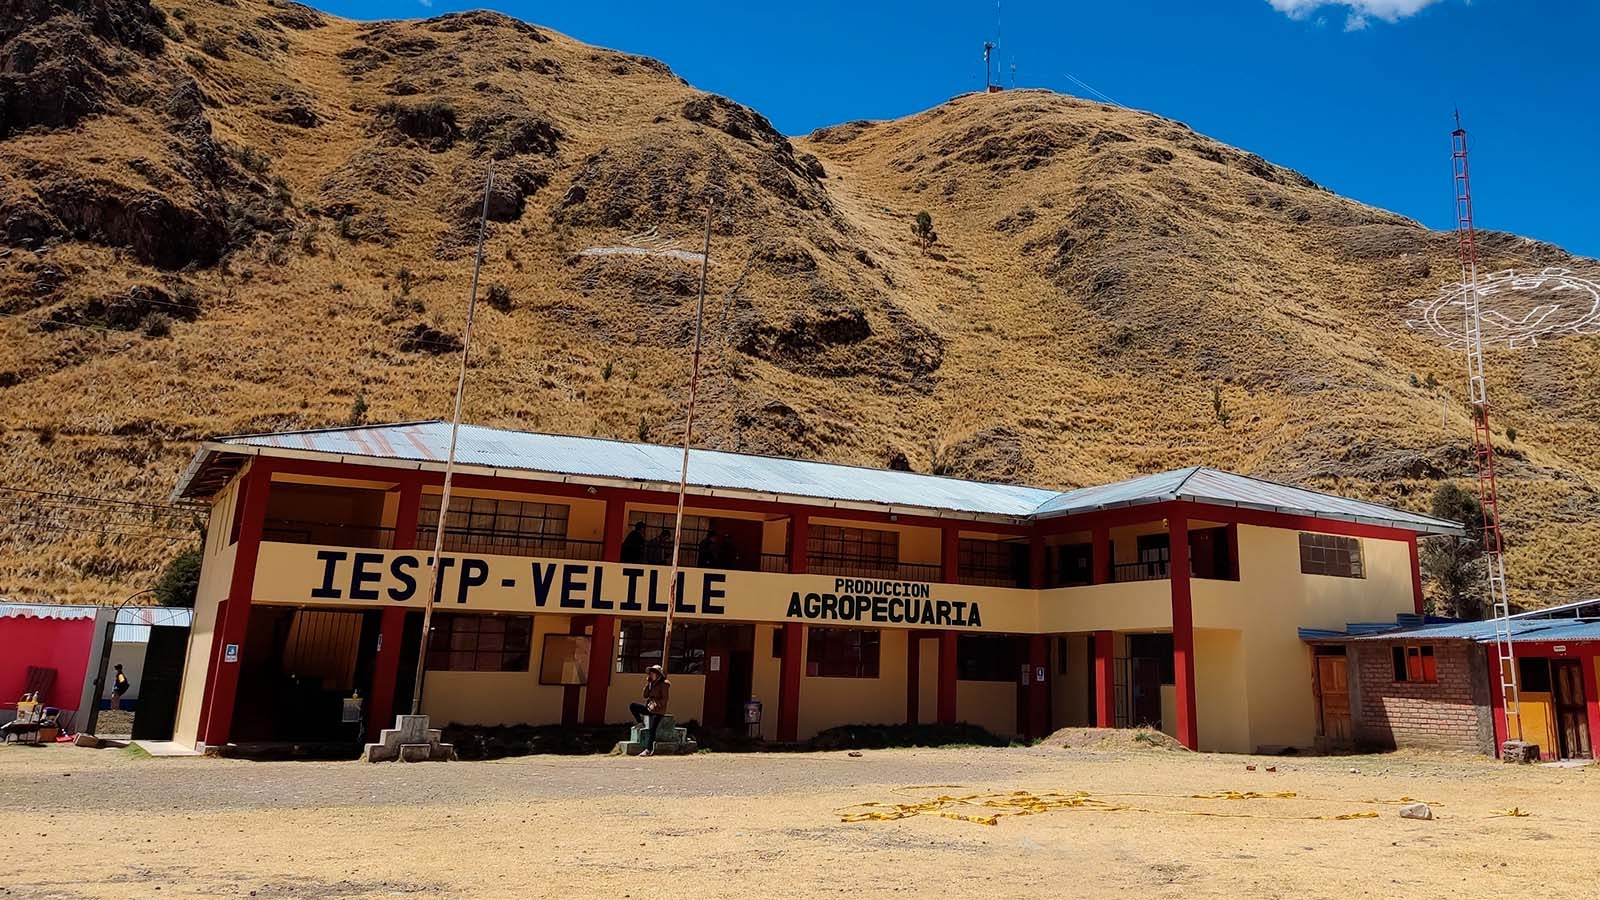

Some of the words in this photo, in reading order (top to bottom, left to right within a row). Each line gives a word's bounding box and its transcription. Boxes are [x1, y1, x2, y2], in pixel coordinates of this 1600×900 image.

[311, 550, 489, 604] IESTP
[532, 563, 727, 615] VELILLE
[834, 578, 930, 598] PRODUCCION
[786, 592, 982, 627] AGROPECUARIA
